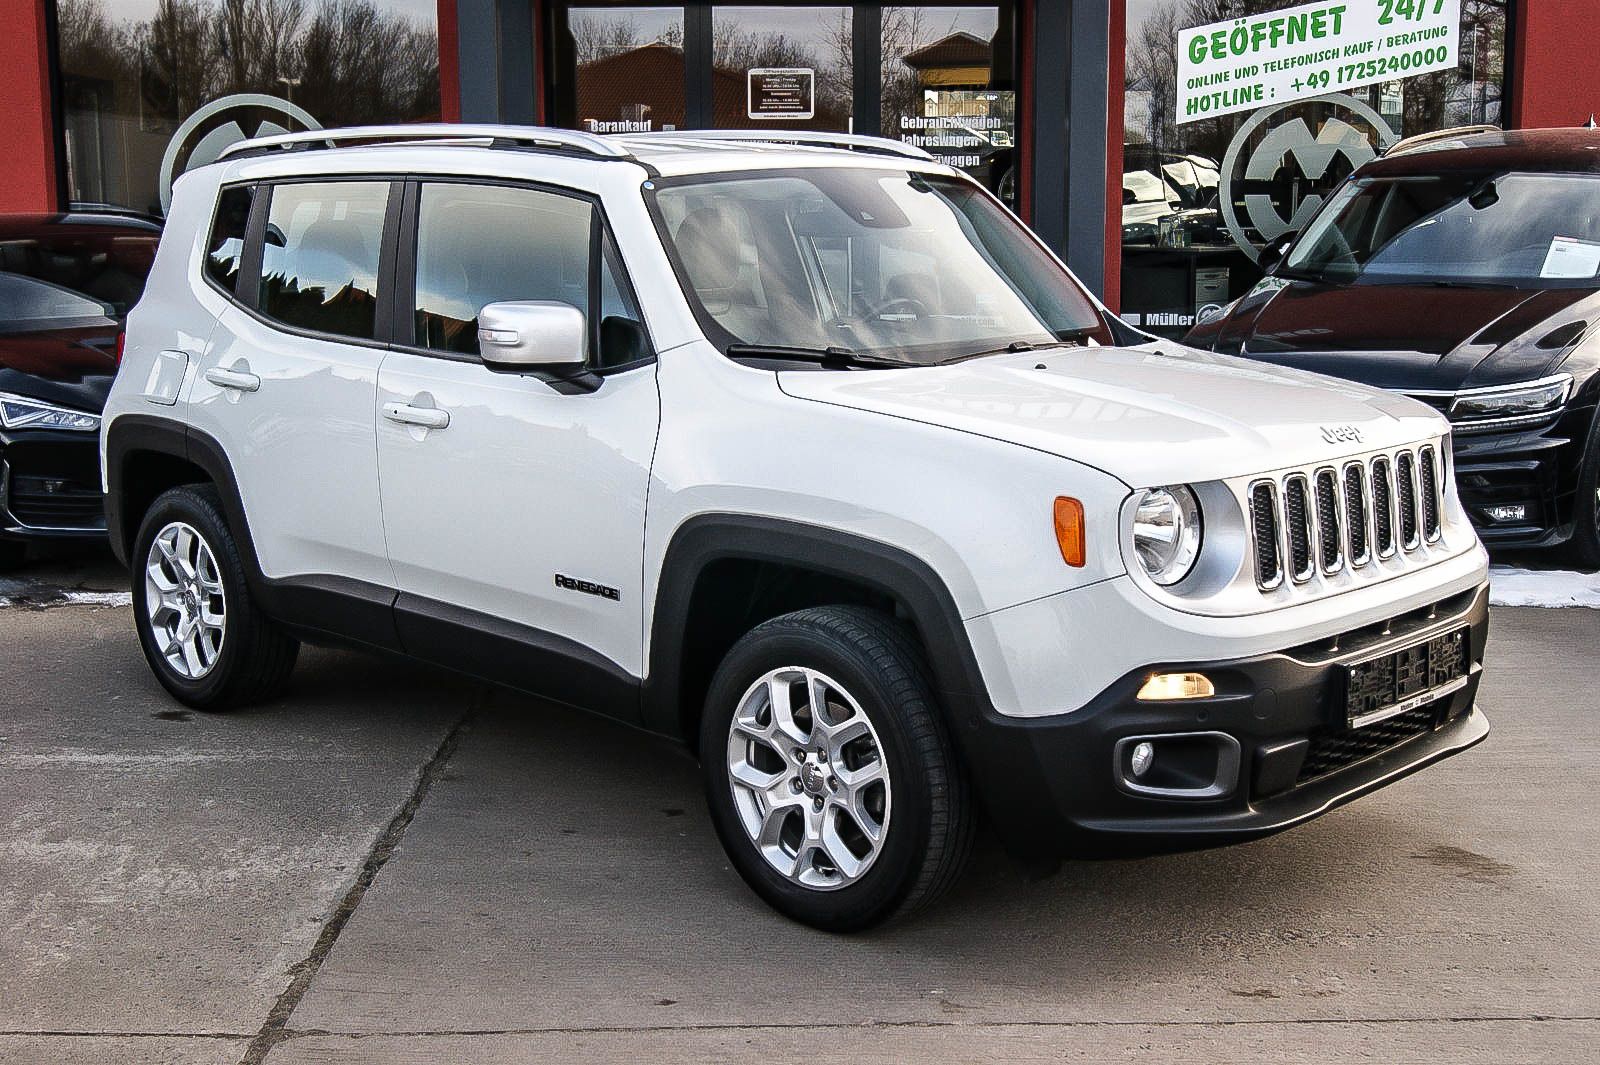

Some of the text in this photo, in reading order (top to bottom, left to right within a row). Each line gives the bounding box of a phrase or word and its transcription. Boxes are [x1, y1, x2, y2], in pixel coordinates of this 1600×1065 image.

[1186, 71, 1230, 90] ONLINE
[1234, 65, 1259, 80] UND
[1262, 48, 1340, 73] TELEFONISCH
[1343, 41, 1374, 57] KAUF
[1386, 26, 1448, 48] BERATUNG
[1188, 5, 1347, 65] GEÖFFNET
[1185, 84, 1264, 116] HOTLINE
[1290, 70, 1330, 93] +49
[1336, 46, 1448, 84] 1725240000
[590, 119, 652, 133] Barankauf
[1145, 313, 1195, 326] Müller
